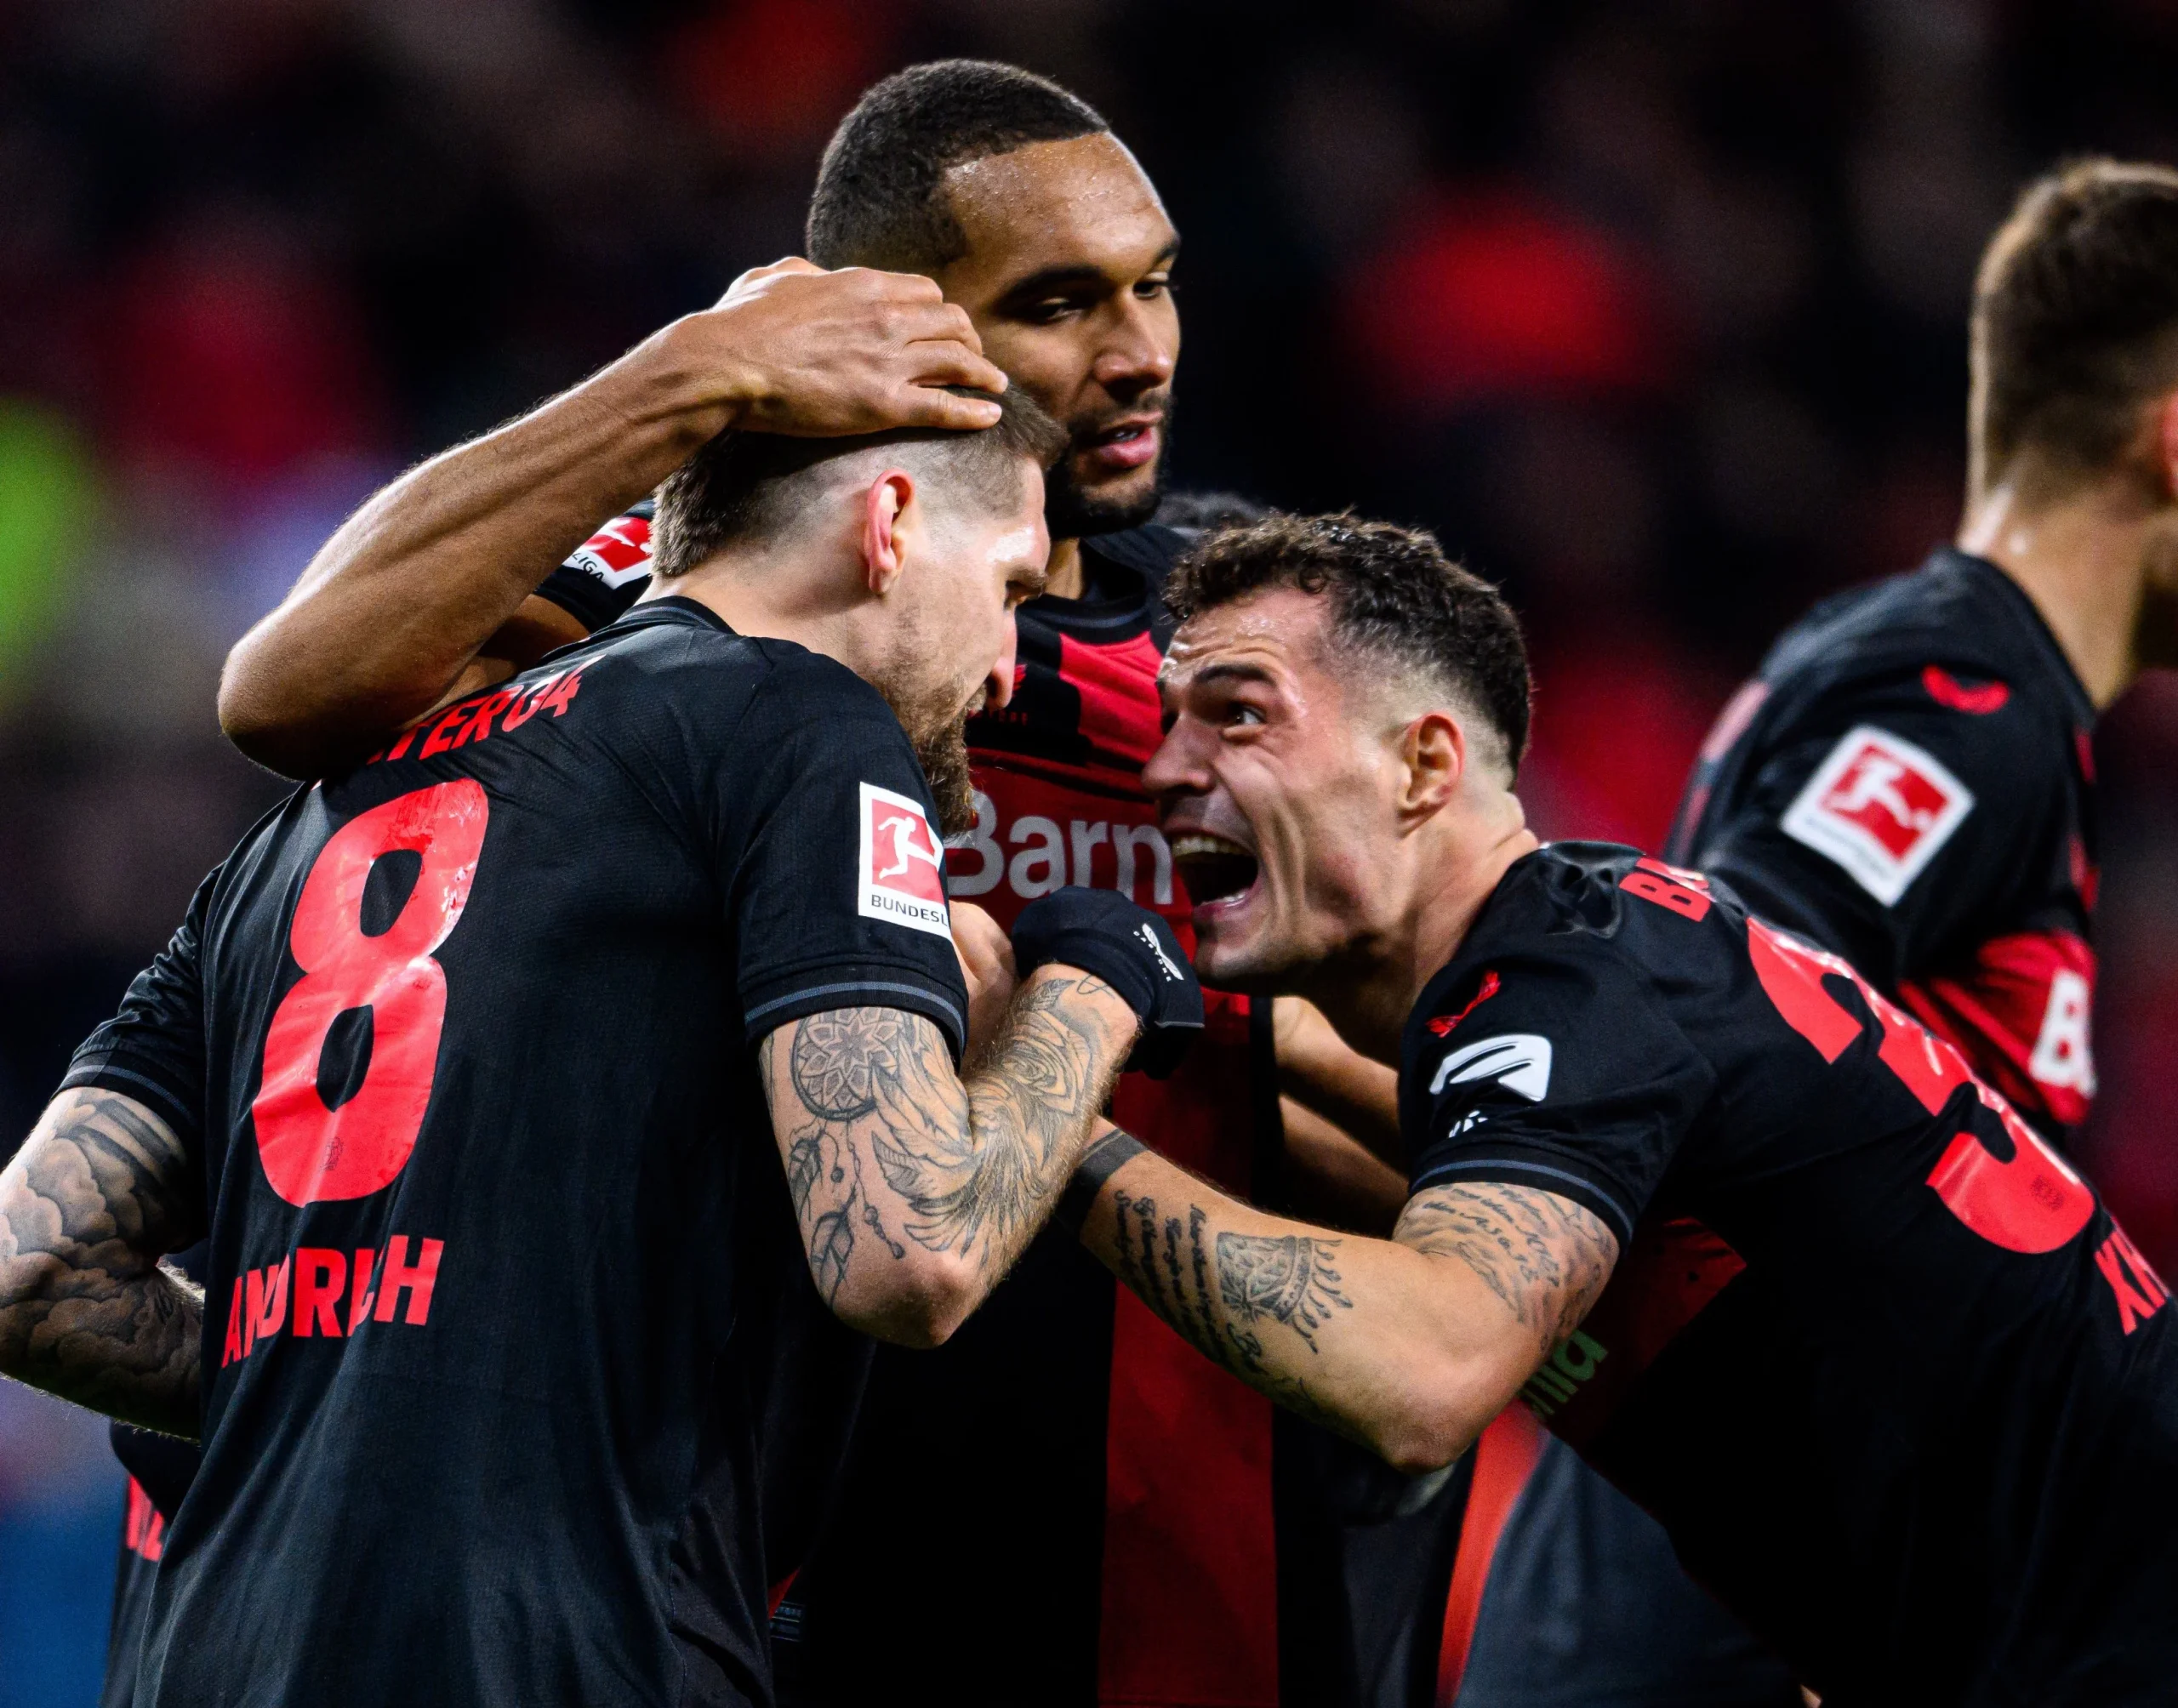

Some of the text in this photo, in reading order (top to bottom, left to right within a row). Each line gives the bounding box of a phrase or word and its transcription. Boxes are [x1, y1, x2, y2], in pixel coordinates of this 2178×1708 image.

[870, 894, 949, 927] BUNDESL
[253, 778, 490, 1208] 8
[2027, 968, 2100, 1100] B
